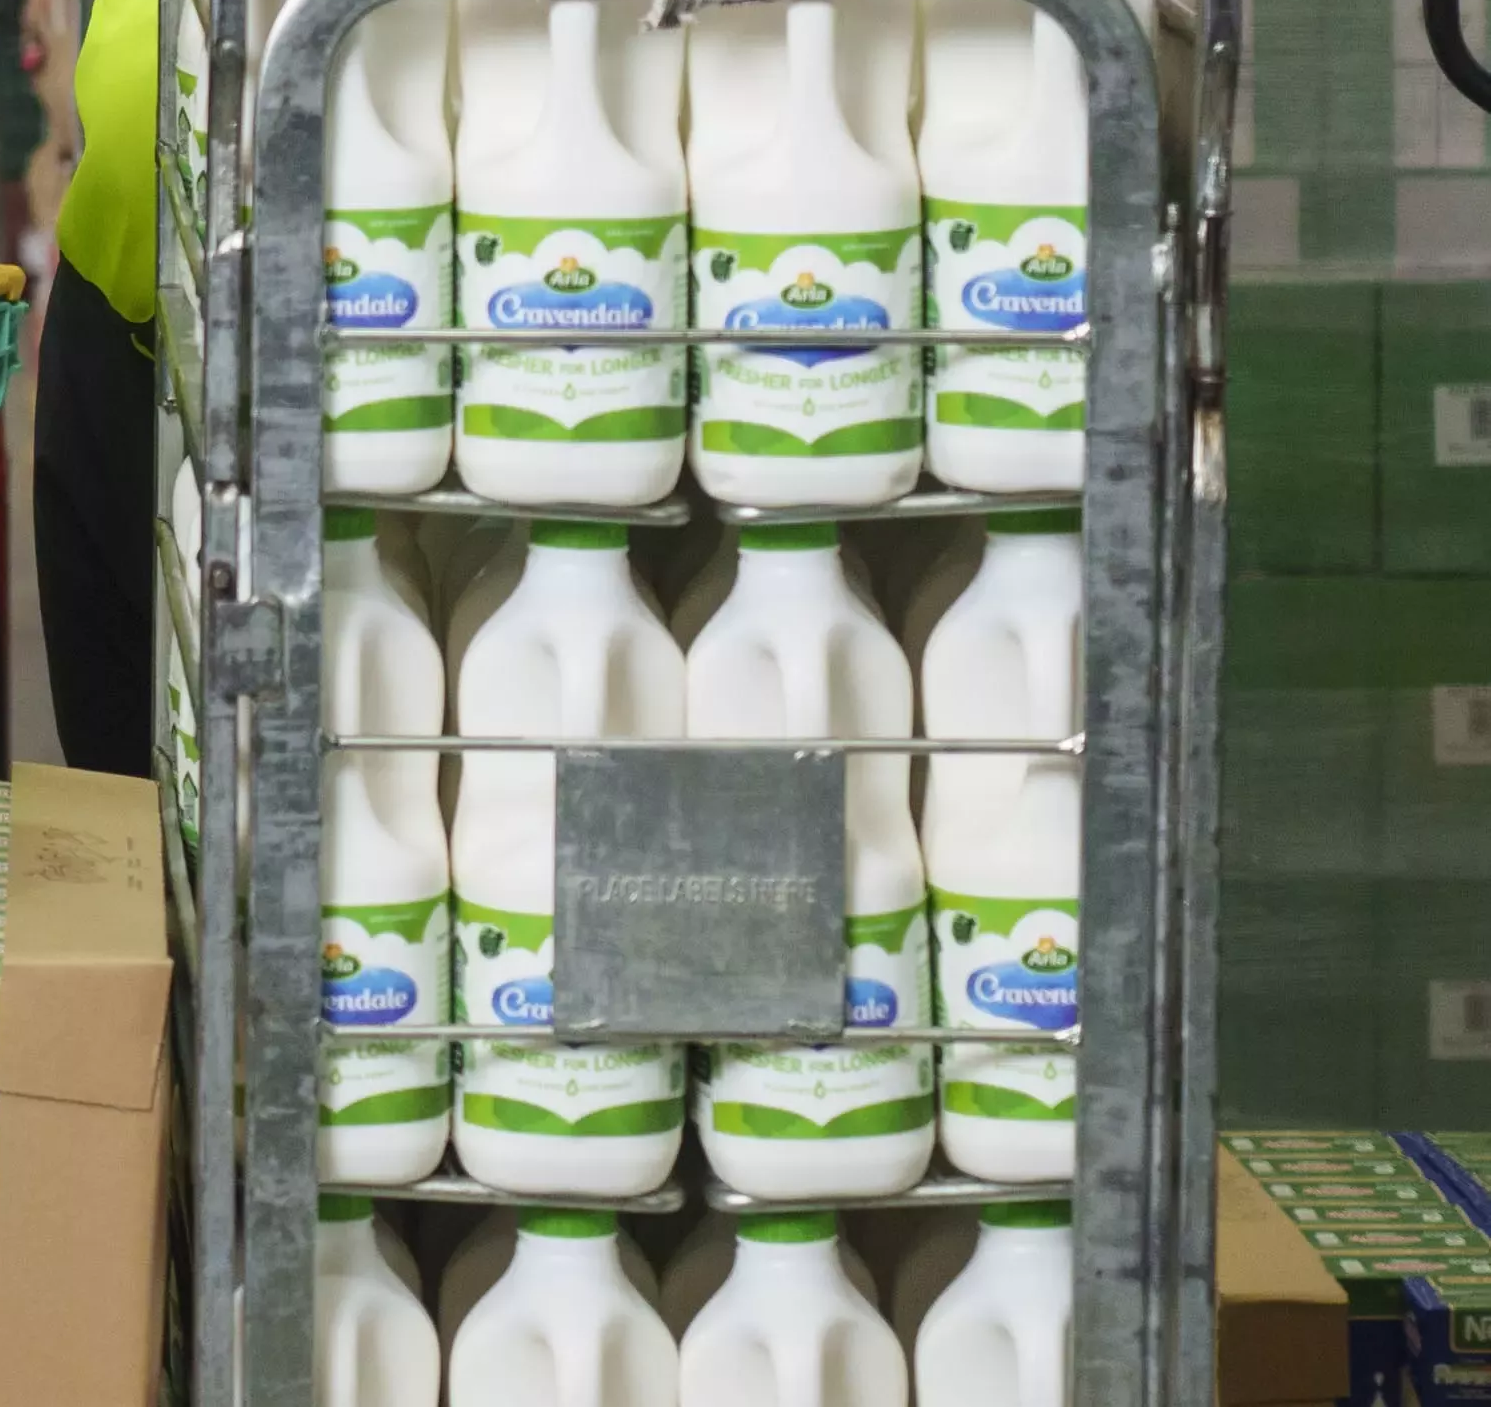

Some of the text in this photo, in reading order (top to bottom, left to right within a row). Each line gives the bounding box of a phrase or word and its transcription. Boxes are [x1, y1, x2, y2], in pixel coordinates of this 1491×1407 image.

[1026, 259, 1068, 276] Arla
[549, 271, 590, 287] Arla
[786, 287, 828, 303] Arla
[494, 292, 645, 327] Cravendale
[719, 357, 792, 390] FRESHER
[1026, 950, 1068, 967] Arla
